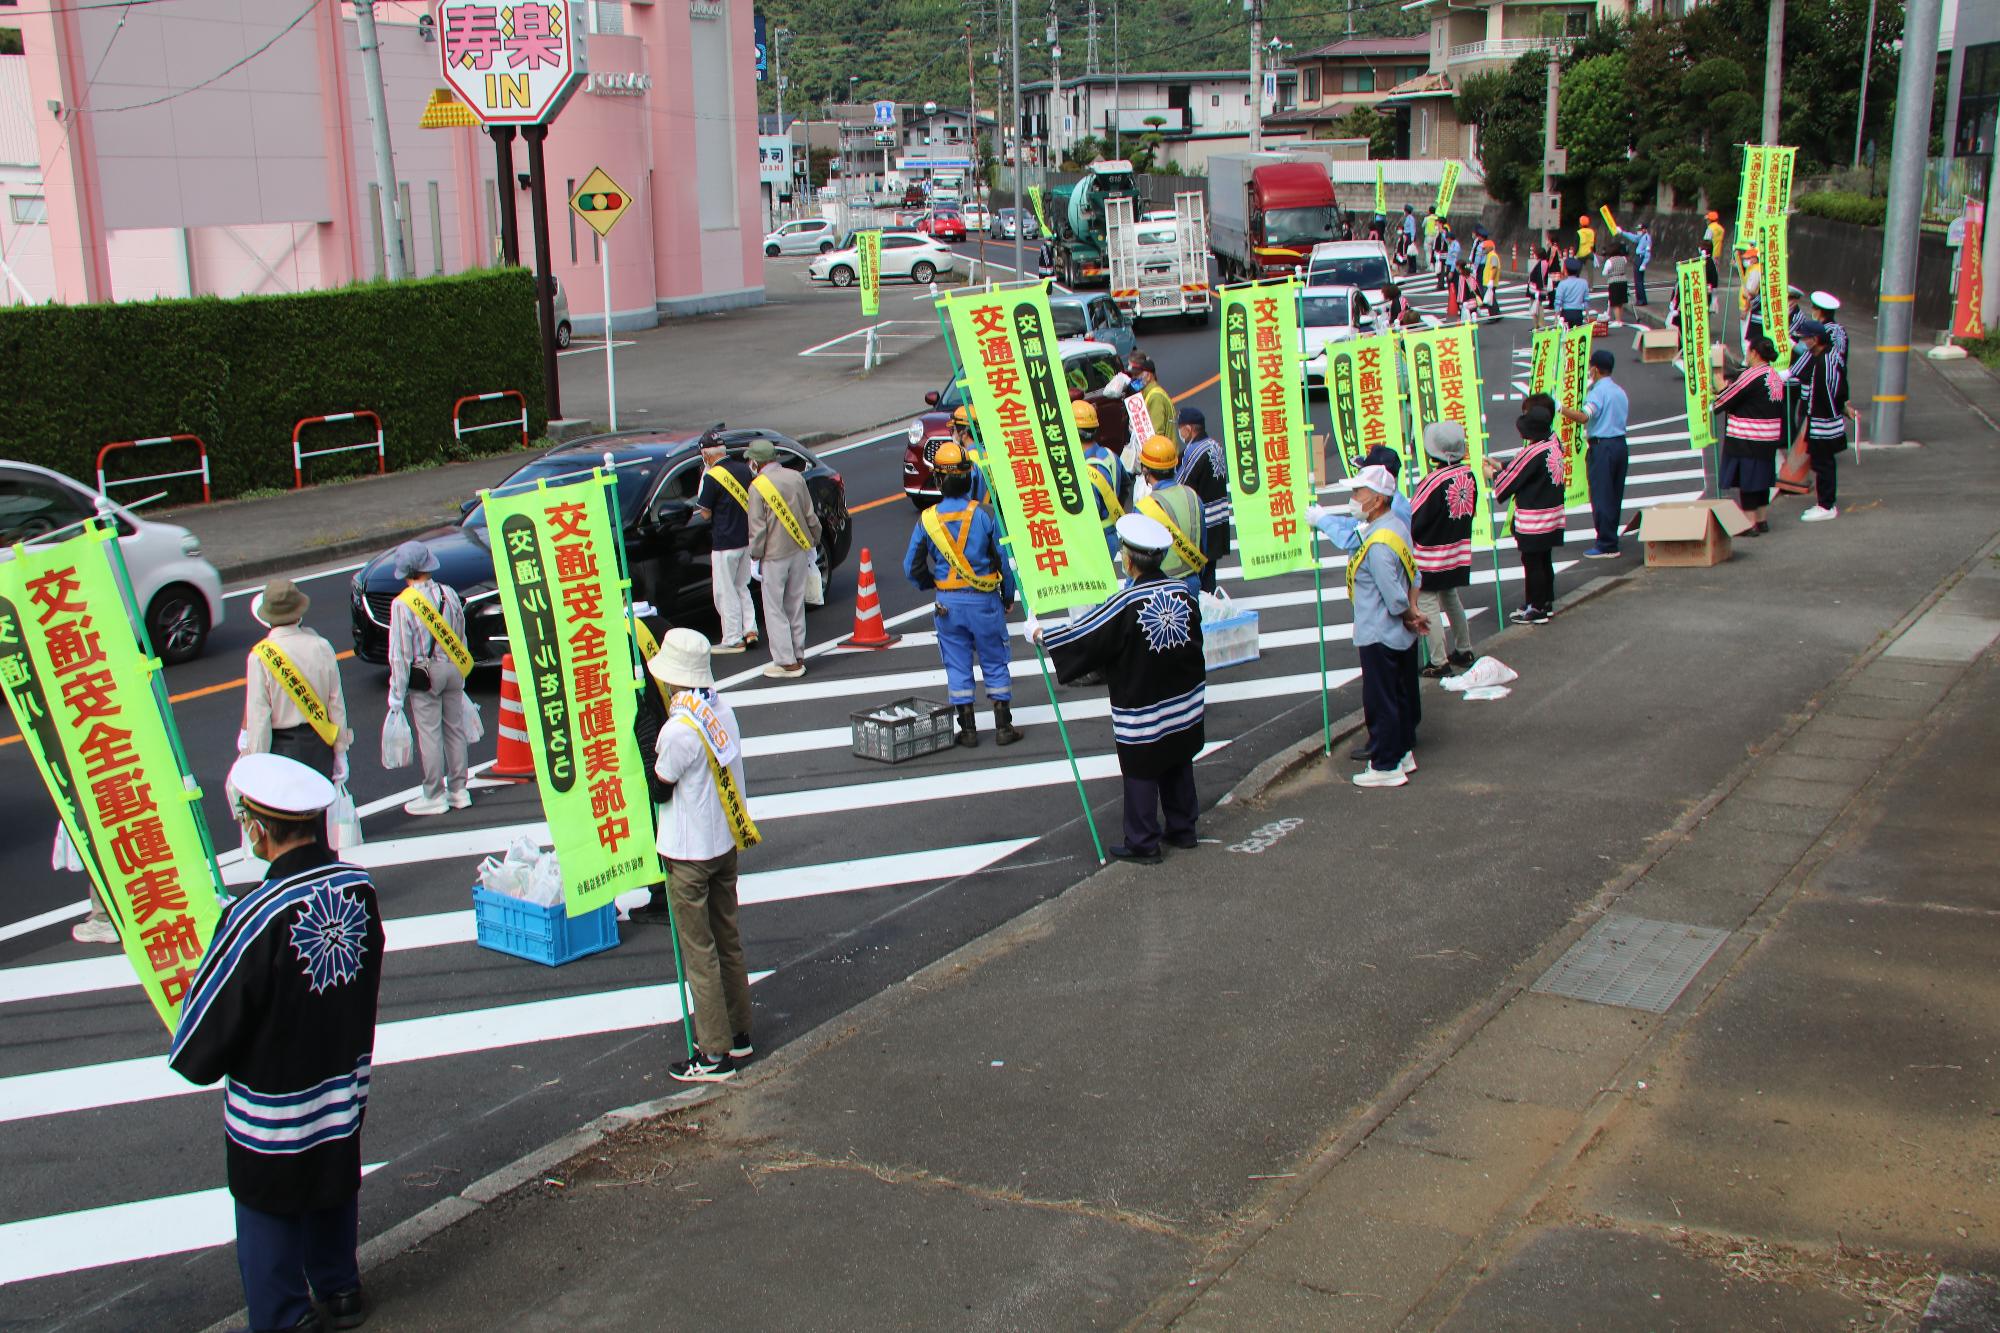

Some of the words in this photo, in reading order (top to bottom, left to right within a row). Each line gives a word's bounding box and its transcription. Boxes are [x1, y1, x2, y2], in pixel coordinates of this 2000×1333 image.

[446, 3, 563, 70] 寿楽
[485, 73, 531, 109] IN
[970, 304, 1069, 577] 交通安全運動実施中
[1018, 314, 1078, 505] 交通ルールを守ろう
[702, 706, 728, 749] FES
